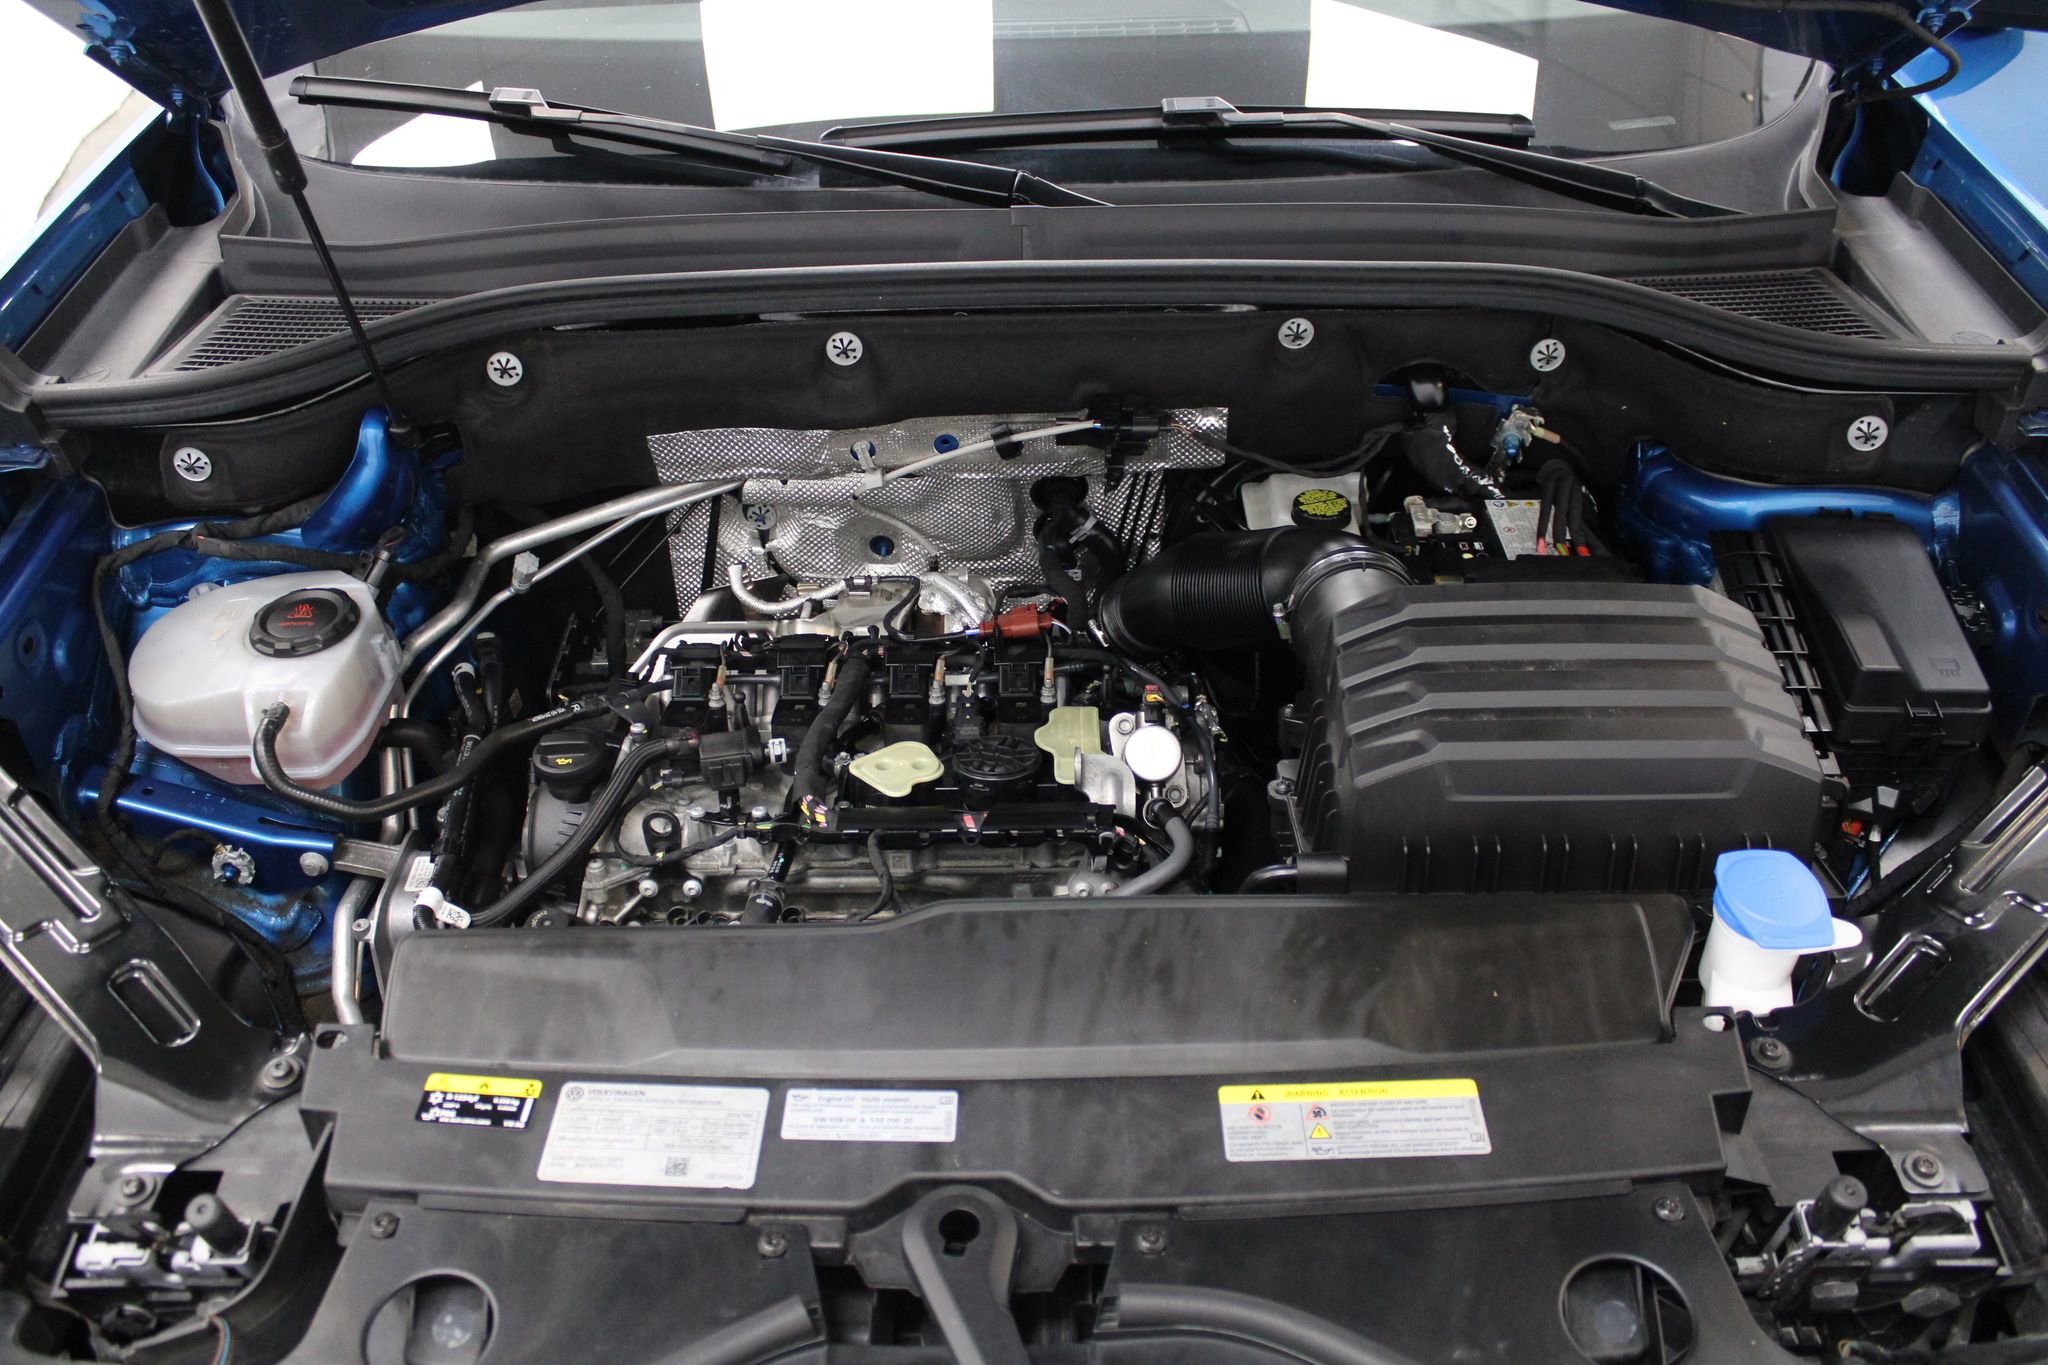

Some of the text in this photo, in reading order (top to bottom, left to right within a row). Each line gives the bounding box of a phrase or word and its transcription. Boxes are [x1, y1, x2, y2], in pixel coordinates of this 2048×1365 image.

[587, 1089, 647, 1098] VOLKSWAGEN
[1284, 1087, 1390, 1098] WARNING ATTENTION
[817, 1095, 843, 1103] Engine
